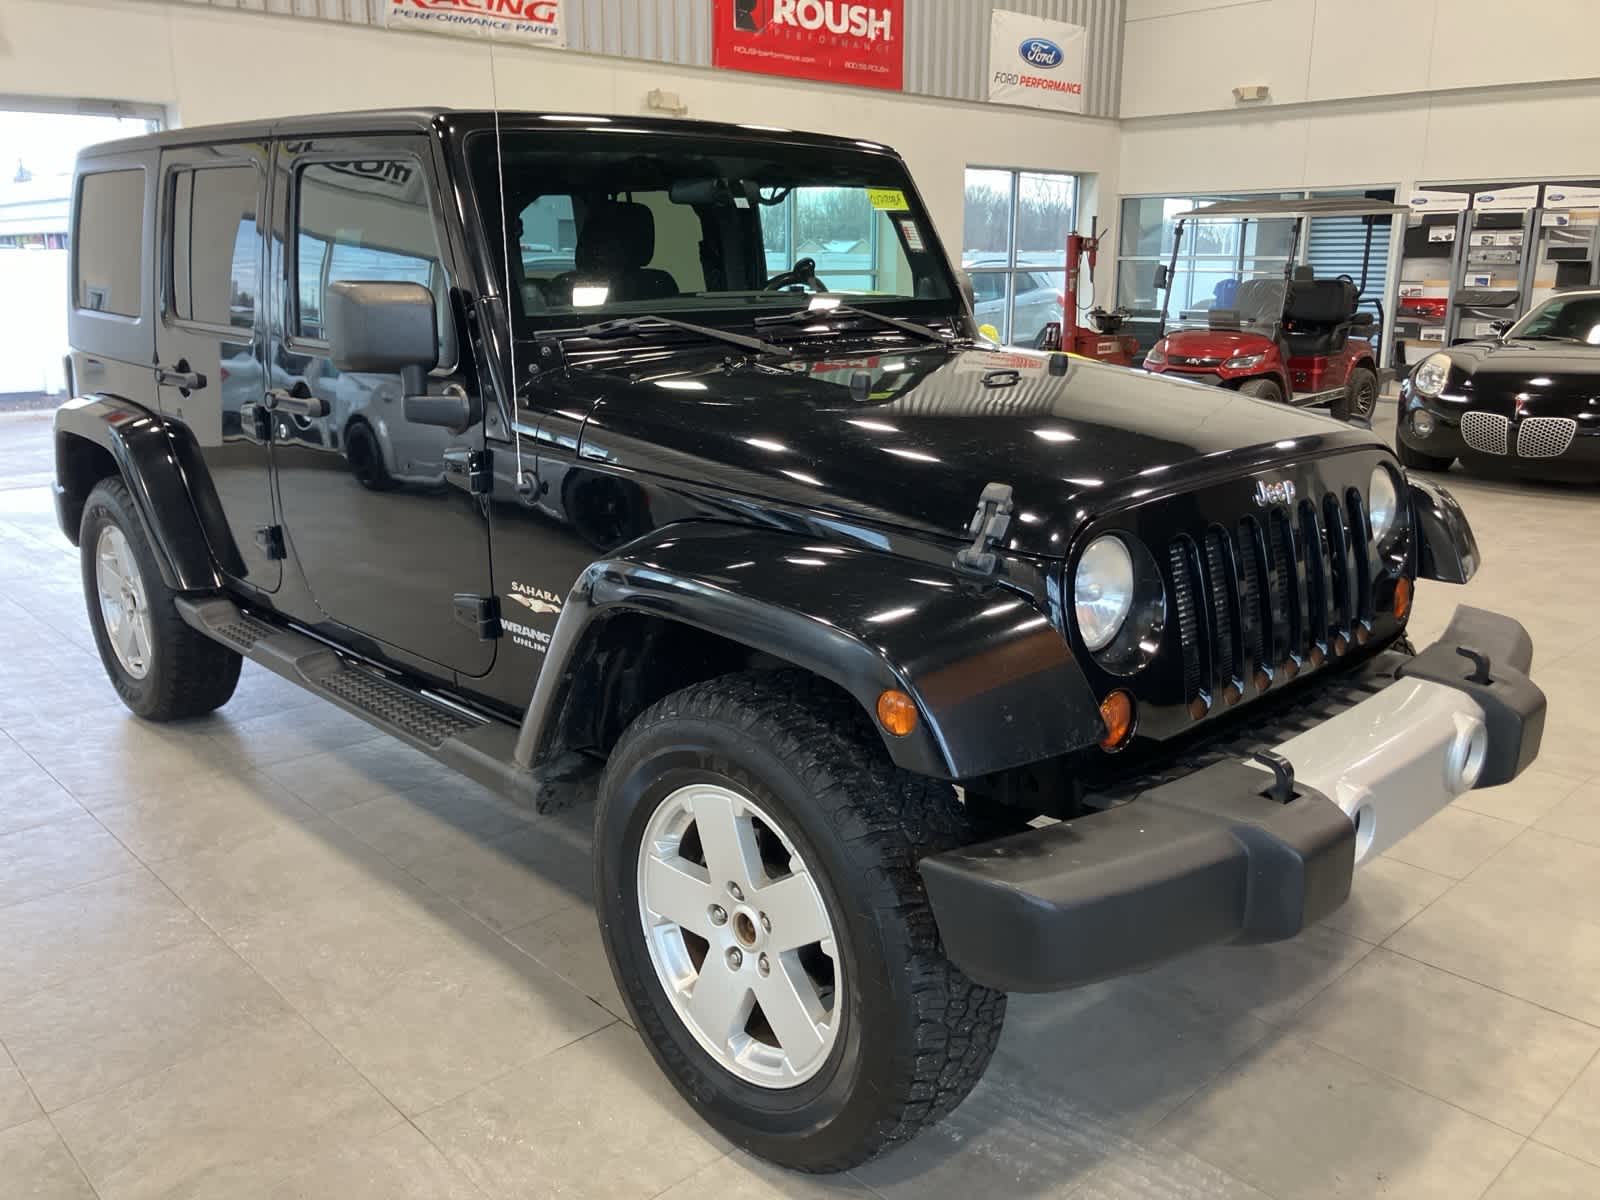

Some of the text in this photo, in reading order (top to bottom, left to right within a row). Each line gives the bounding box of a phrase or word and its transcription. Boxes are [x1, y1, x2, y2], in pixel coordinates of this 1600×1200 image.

[393, 8, 558, 36] PERFORMANCE PARTS
[773, 0, 892, 41] ROUSH
[1027, 41, 1056, 64] Ford
[993, 71, 1082, 95] FORD PERFORMANCE
[1252, 480, 1296, 507] Jeep
[511, 581, 562, 605] SAHARA
